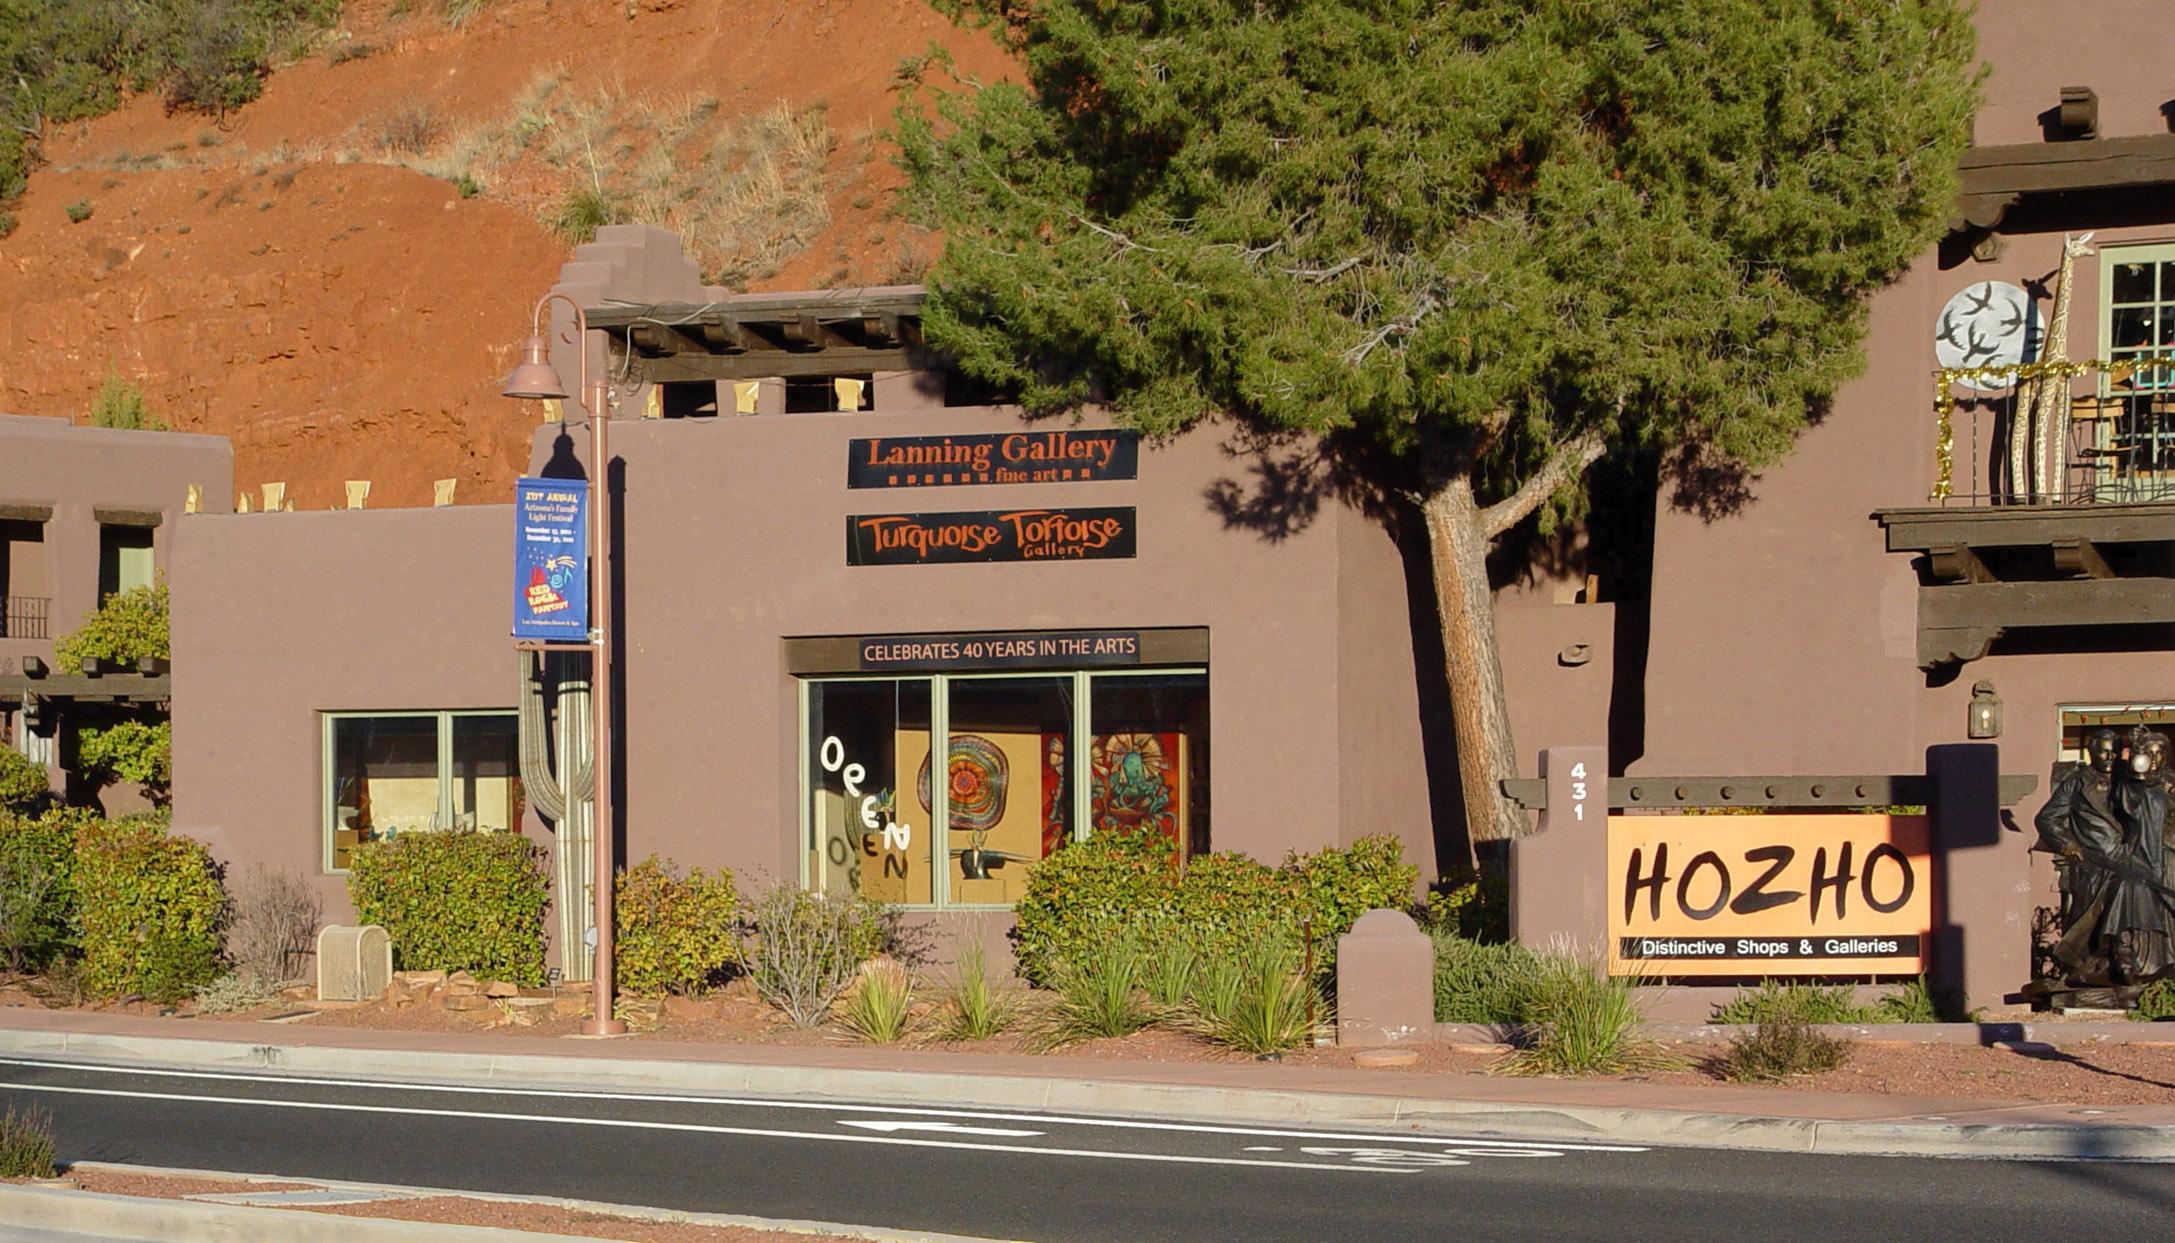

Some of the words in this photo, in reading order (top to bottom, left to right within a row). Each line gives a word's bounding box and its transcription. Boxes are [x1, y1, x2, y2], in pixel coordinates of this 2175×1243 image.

[868, 438, 993, 471] Lanning
[1001, 432, 1117, 468] Gallery
[996, 467, 1028, 483] fine
[1033, 468, 1058, 481] art
[529, 512, 546, 523] Light
[548, 513, 573, 523] Festival
[859, 515, 1002, 557] Turquoise
[999, 510, 1122, 548] Tortoise
[1024, 542, 1084, 558] Gallery
[529, 584, 550, 597] RED
[864, 643, 960, 661] CELEBRATES
[963, 642, 983, 658] 40
[985, 641, 1036, 658] YEARS
[1040, 640, 1057, 656] IN
[1059, 639, 1090, 655] THE
[1094, 637, 1136, 654] ARTS
[1624, 840, 1915, 926] HOZHO
[1642, 938, 1726, 956] Distinctive
[1736, 939, 1789, 957] Shops
[1799, 939, 1814, 955] &
[1824, 938, 1898, 954] Galleries
